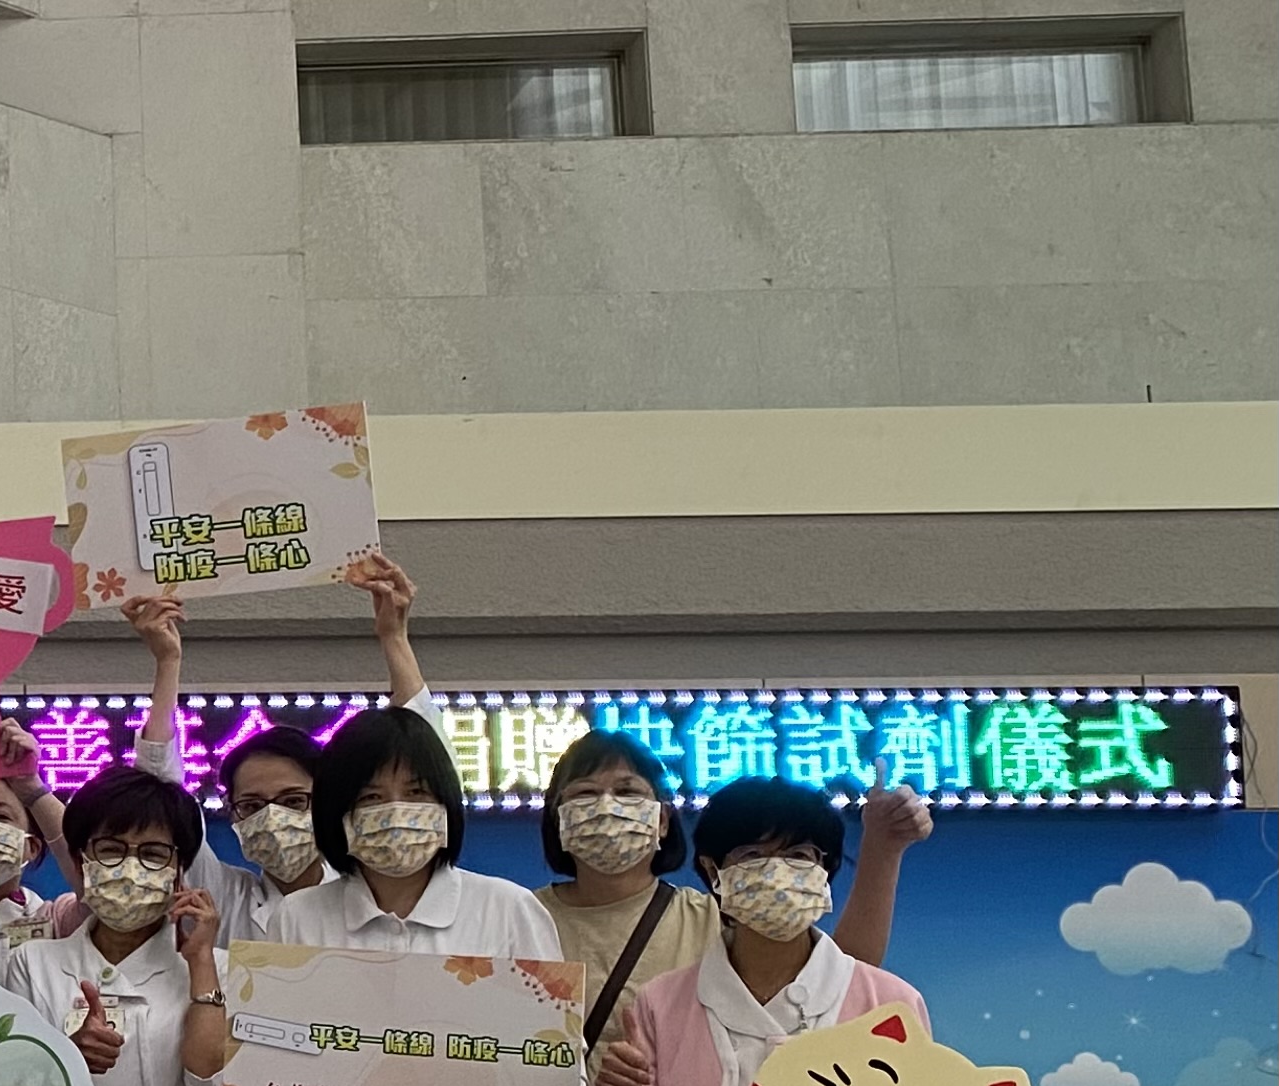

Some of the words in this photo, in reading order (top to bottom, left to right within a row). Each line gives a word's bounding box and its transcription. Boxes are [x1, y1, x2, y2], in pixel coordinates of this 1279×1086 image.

[150, 503, 308, 548] 平安一條線
[154, 538, 311, 584] 防疫一條心
[309, 1023, 435, 1058] 平安一條線
[446, 1034, 576, 1068] 防疫一條心
